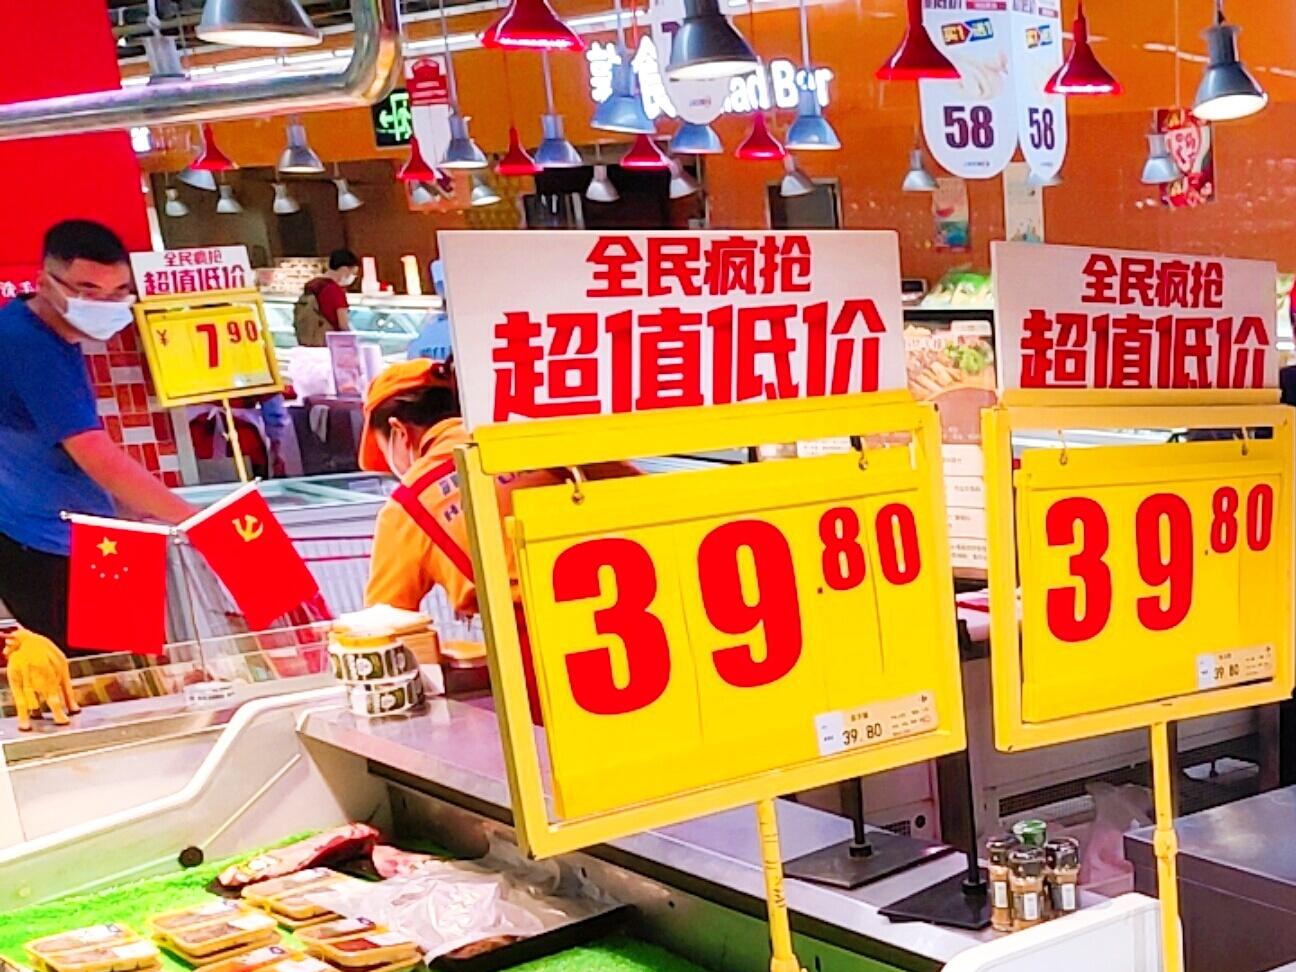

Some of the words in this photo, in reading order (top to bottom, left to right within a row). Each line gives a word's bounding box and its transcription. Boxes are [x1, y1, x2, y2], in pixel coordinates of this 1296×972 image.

[943, 105, 995, 149] 58
[1028, 106, 1055, 150] 58
[586, 235, 812, 298] 全民疯抢
[1080, 254, 1224, 309] 全民疯抢
[492, 298, 887, 422] 超值低价
[1019, 309, 1270, 389] 超值低价
